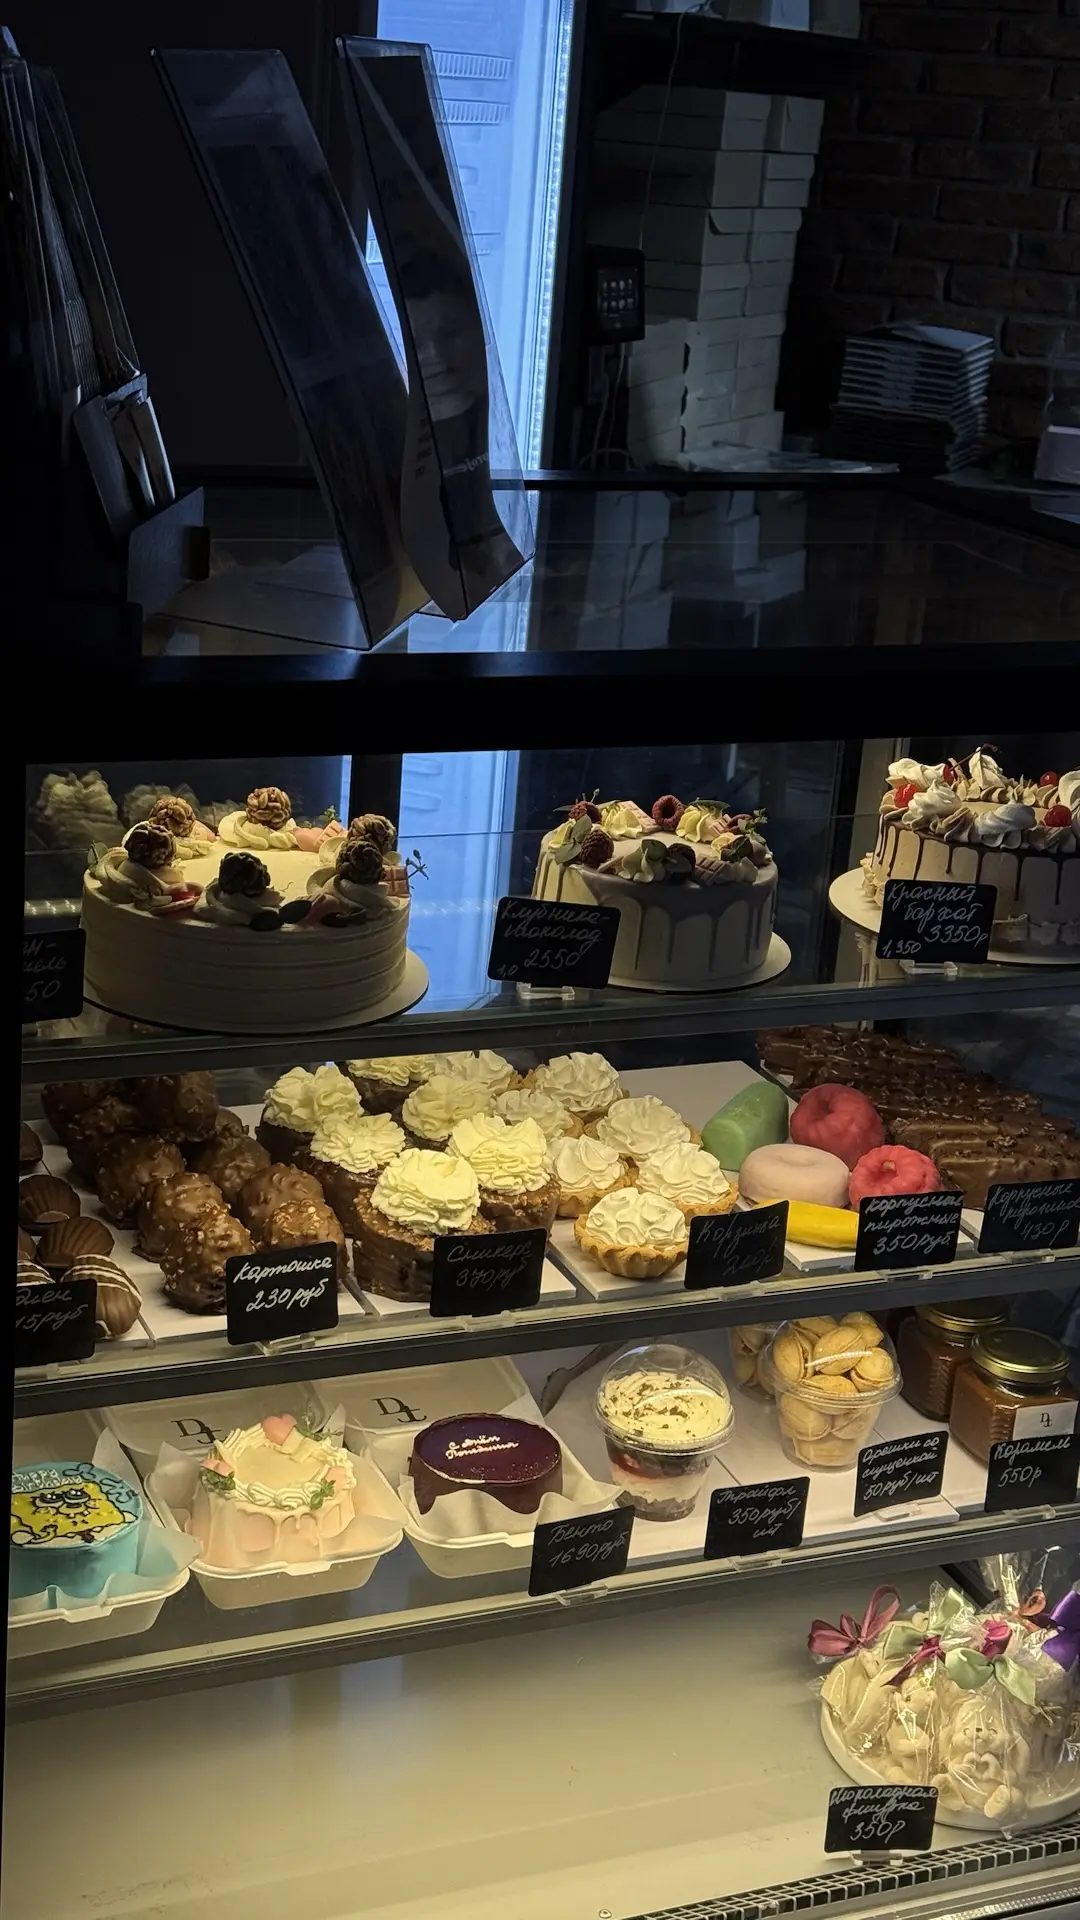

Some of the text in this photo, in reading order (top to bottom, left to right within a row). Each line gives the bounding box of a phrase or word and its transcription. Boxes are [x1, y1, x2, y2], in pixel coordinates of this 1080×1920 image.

[524, 948, 579, 970] 2550
[882, 940, 922, 959] 1,350
[233, 1257, 333, 1284] Картошка
[548, 1520, 614, 1546] Бенто
